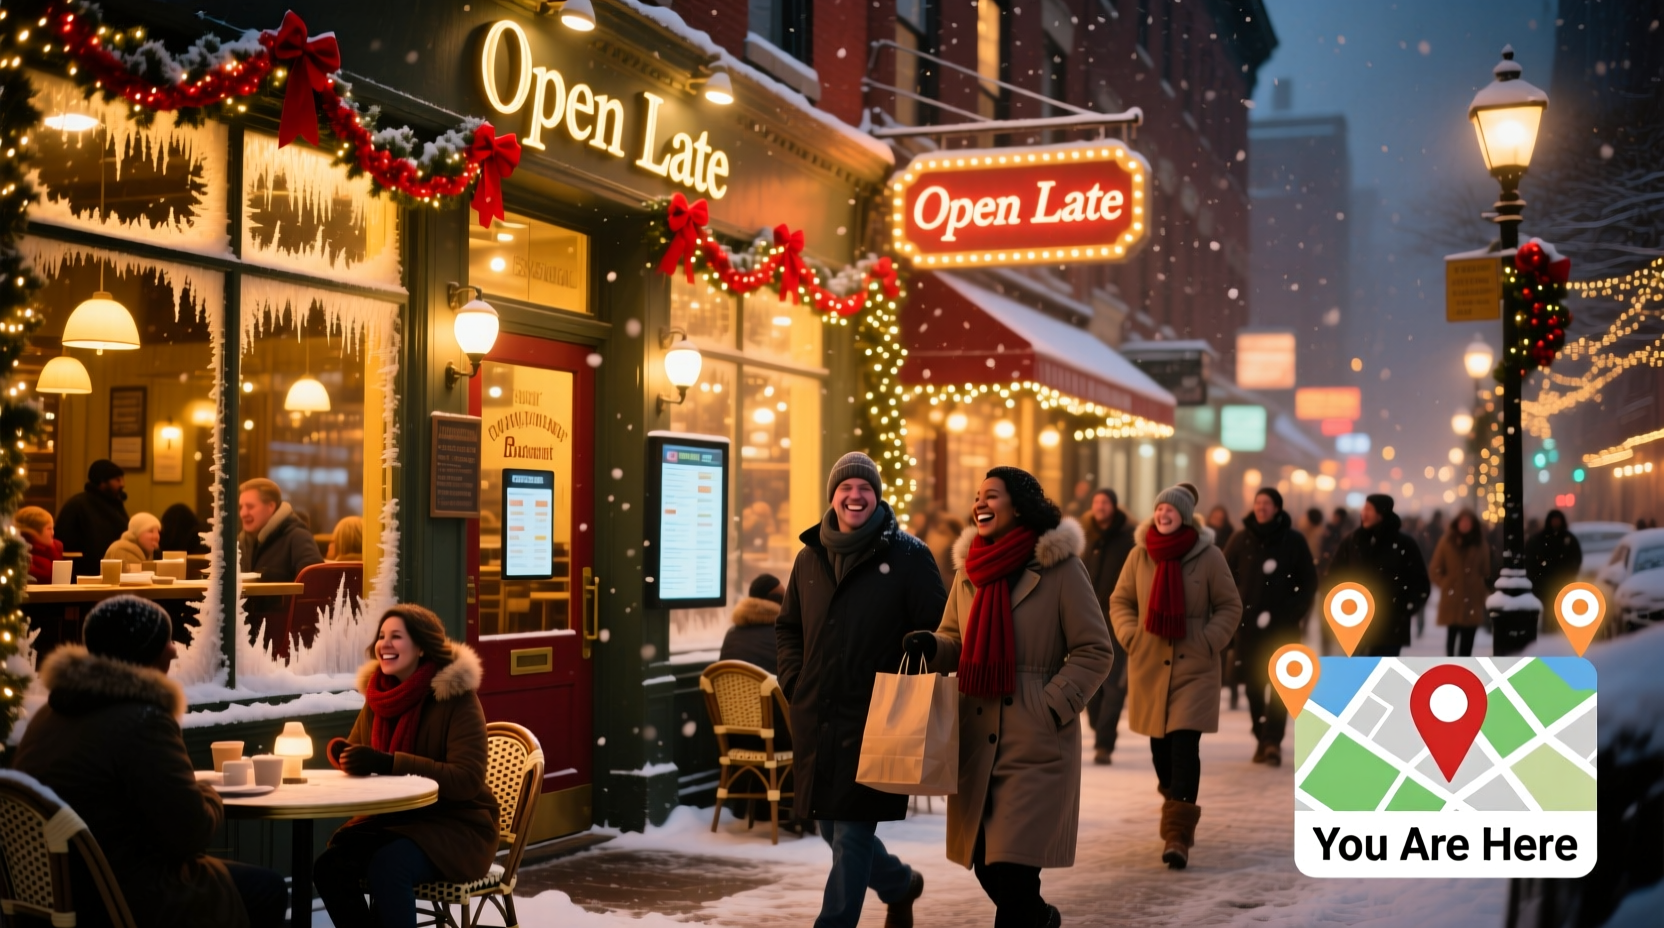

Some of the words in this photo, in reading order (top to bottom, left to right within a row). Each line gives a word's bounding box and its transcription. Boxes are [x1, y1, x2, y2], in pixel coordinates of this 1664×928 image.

[481, 19, 625, 158] Open
[635, 91, 730, 200] Late
[913, 186, 1021, 242] Open
[1030, 180, 1124, 224] Late
